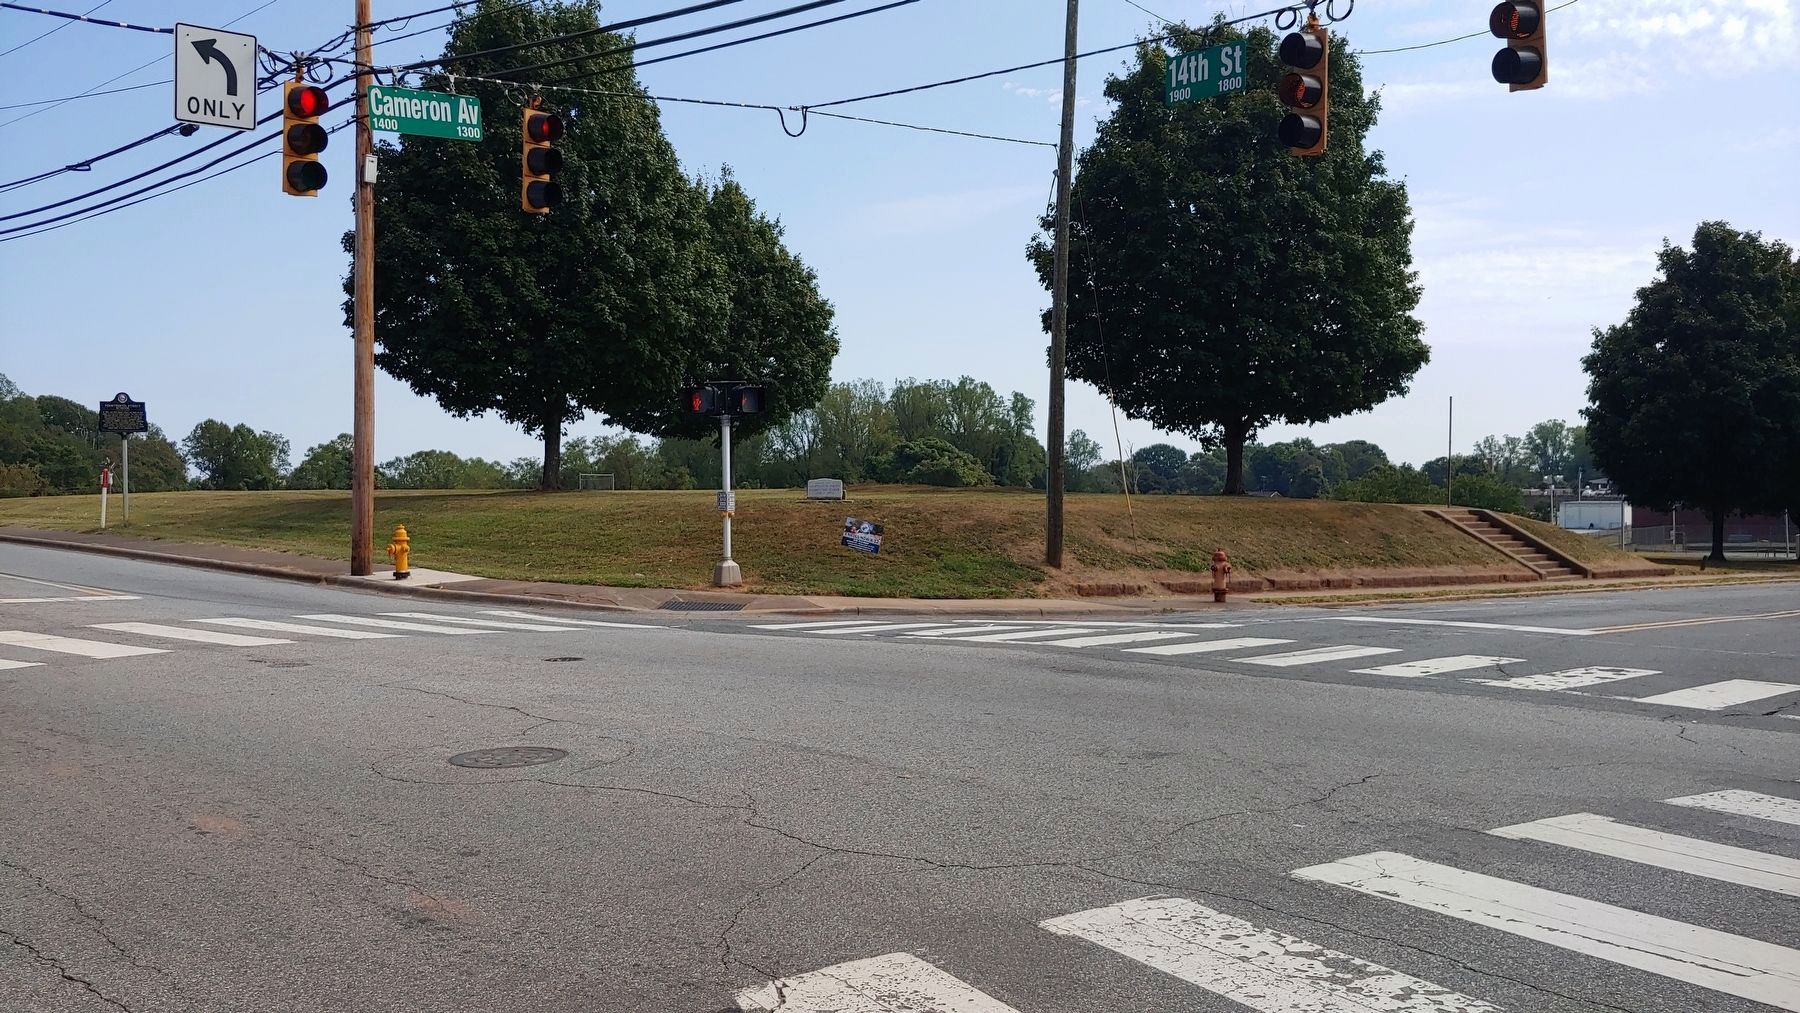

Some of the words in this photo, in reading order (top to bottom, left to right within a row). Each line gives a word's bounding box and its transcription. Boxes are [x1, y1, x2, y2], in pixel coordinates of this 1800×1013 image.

[1169, 54, 1208, 87] 14th
[1221, 45, 1242, 76] St
[1218, 76, 1242, 92] 1800
[1169, 87, 1191, 102] 1900
[187, 96, 245, 120] ONLY
[370, 87, 452, 122] Cameron
[458, 98, 478, 124] Av
[373, 117, 398, 130] 1400
[457, 126, 480, 138] 1300
